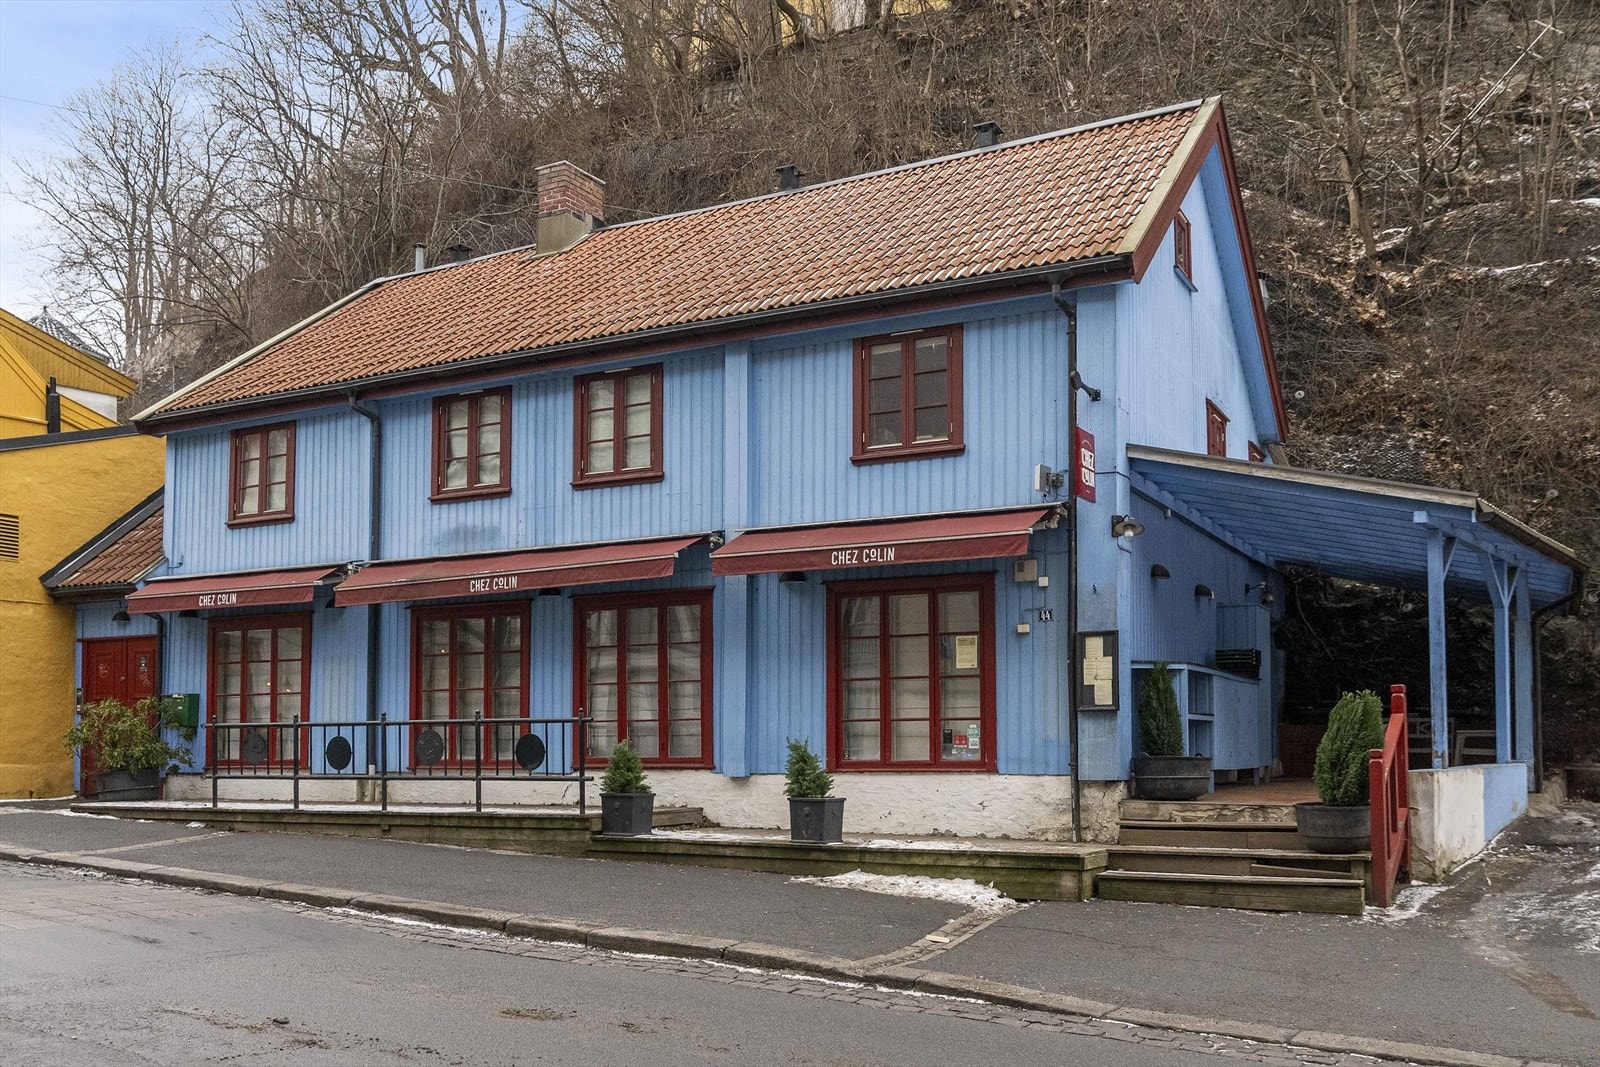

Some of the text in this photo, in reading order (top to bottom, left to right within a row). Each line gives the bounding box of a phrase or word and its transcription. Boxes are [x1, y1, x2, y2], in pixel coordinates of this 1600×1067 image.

[1081, 447, 1094, 469] CHEZ
[831, 549, 859, 565] CHEZ
[470, 578, 490, 592] CHEZ
[199, 594, 216, 606] CHEZ
[1041, 610, 1050, 620] 44
